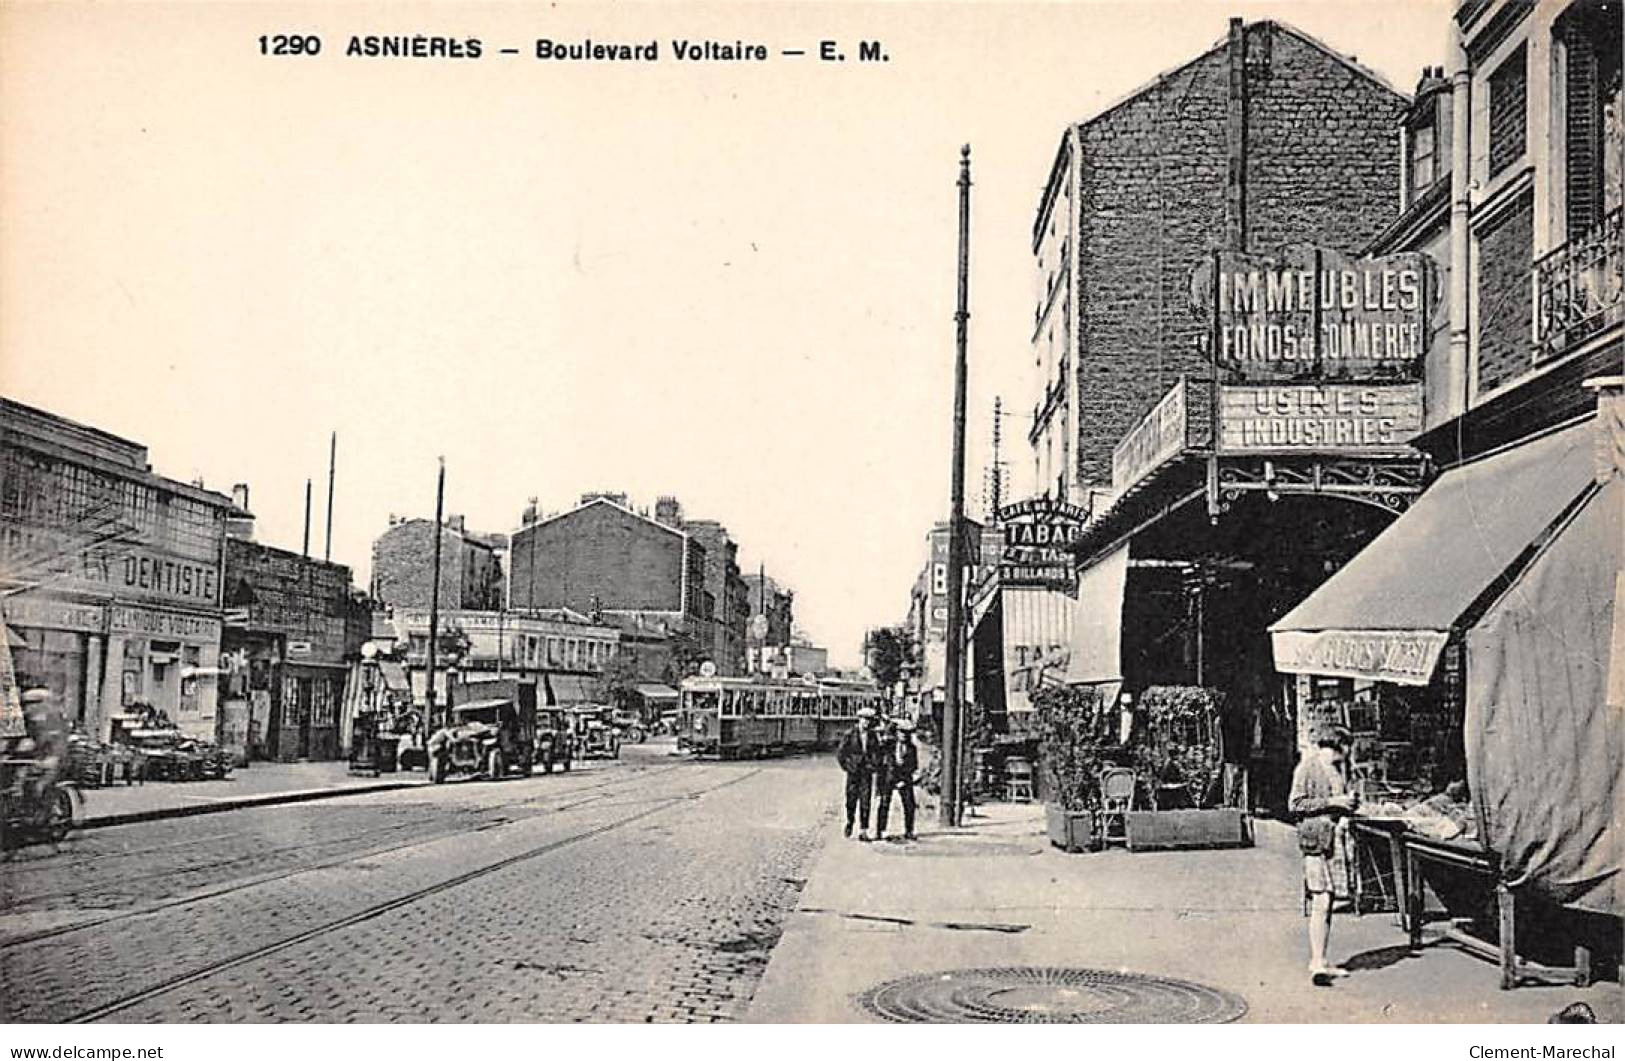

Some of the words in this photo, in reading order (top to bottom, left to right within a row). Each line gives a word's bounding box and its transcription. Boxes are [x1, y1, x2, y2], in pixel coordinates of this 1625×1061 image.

[1219, 270, 1418, 312] IMMEUBLES
[1222, 324, 1296, 359] FONDS
[1320, 322, 1418, 359] COMMERCE
[1256, 387, 1377, 413] USINES
[1242, 418, 1394, 444] INDUSTRIES
[125, 556, 214, 598] DENTISTE
